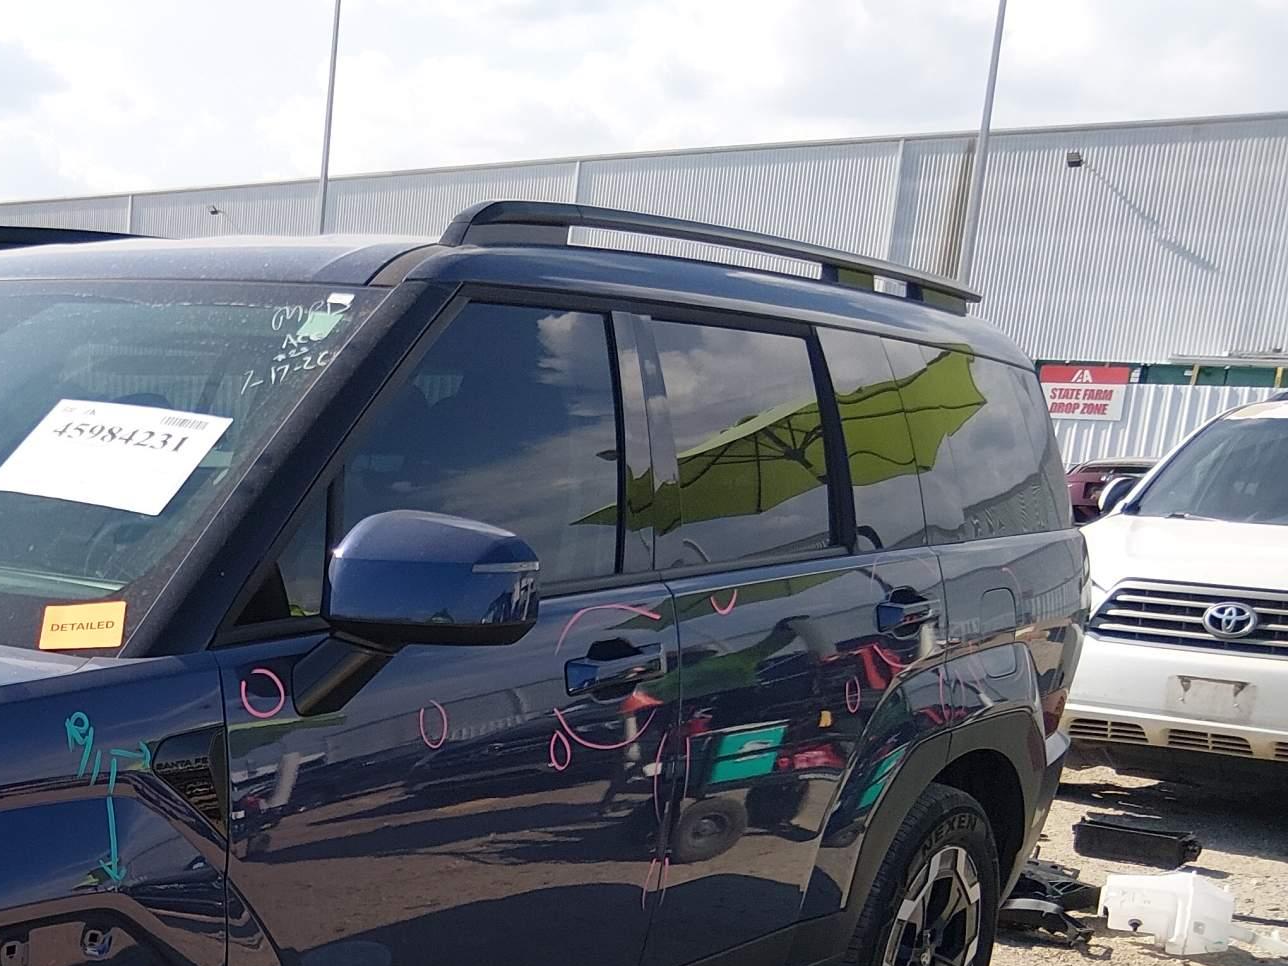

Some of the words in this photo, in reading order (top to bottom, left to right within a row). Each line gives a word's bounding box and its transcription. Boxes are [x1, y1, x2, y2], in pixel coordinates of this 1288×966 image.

[1050, 387, 1083, 400] STATE
[1082, 389, 1114, 401] FARM
[1049, 402, 1080, 414] DROP
[1080, 403, 1110, 415] ZONE
[53, 421, 190, 453] 45984231
[50, 620, 116, 632] DETAILED
[920, 812, 978, 860] NEXEN
